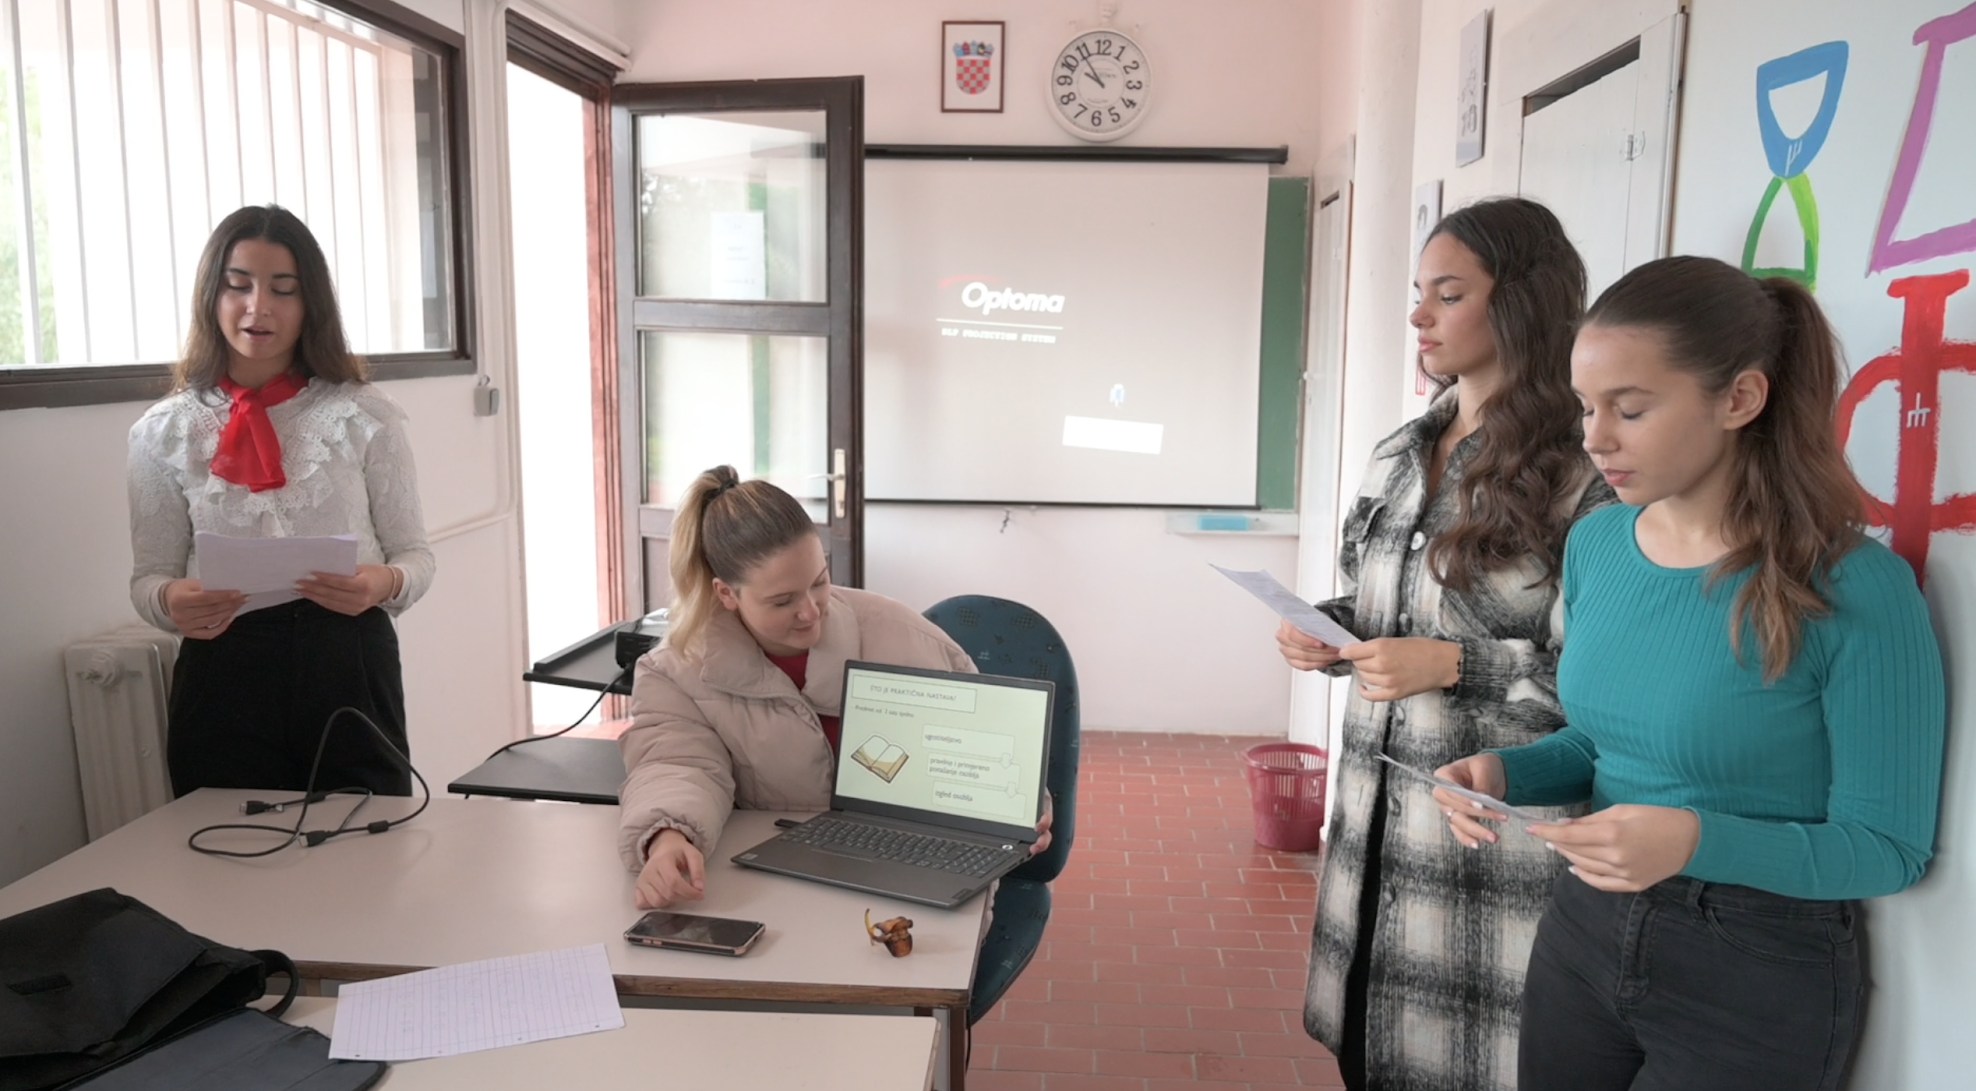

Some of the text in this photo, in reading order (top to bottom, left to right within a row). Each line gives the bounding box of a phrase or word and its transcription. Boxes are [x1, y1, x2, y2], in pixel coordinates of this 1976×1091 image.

[1075, 42, 1092, 62] 11
[1095, 39, 1112, 56] 12
[1113, 45, 1126, 62] 1
[1061, 54, 1079, 75] 10
[1123, 60, 1140, 75] 2
[1056, 75, 1073, 86] 9
[1126, 80, 1143, 91] 3
[1060, 92, 1076, 106] 8
[1120, 96, 1137, 109] 4
[1073, 103, 1088, 120] 7
[1091, 110, 1102, 126] 6
[1107, 106, 1121, 123] 5
[961, 281, 1065, 316] Optoma
[962, 329, 1018, 341] PROJECTION
[1021, 333, 1057, 344] SYSTEM
